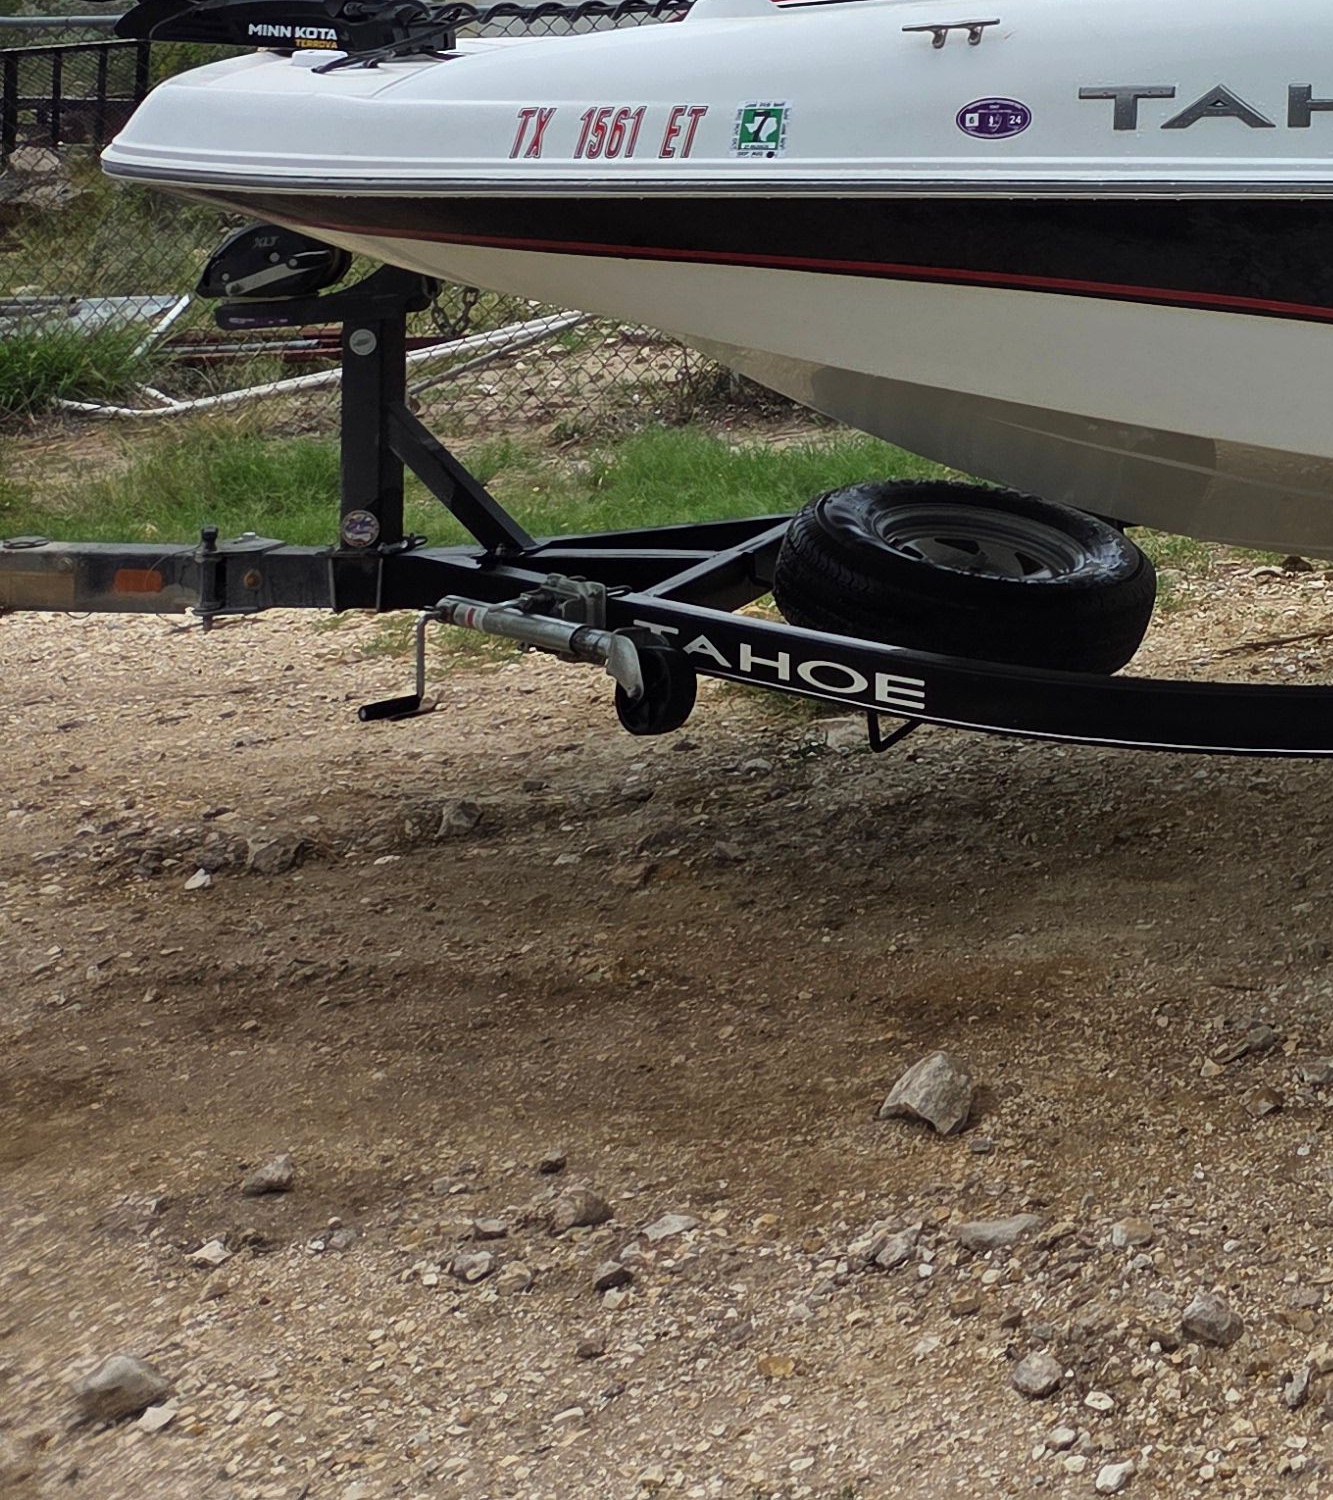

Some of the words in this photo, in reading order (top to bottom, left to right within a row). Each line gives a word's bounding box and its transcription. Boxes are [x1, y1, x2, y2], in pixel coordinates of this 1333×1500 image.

[248, 23, 292, 38] MINN
[294, 26, 338, 41] KOTA
[294, 39, 338, 49] TERROVA
[1009, 115, 1022, 125] 24
[509, 106, 557, 159] TX
[573, 106, 648, 160] 1561
[658, 105, 709, 160] ET
[254, 235, 279, 249] XLT
